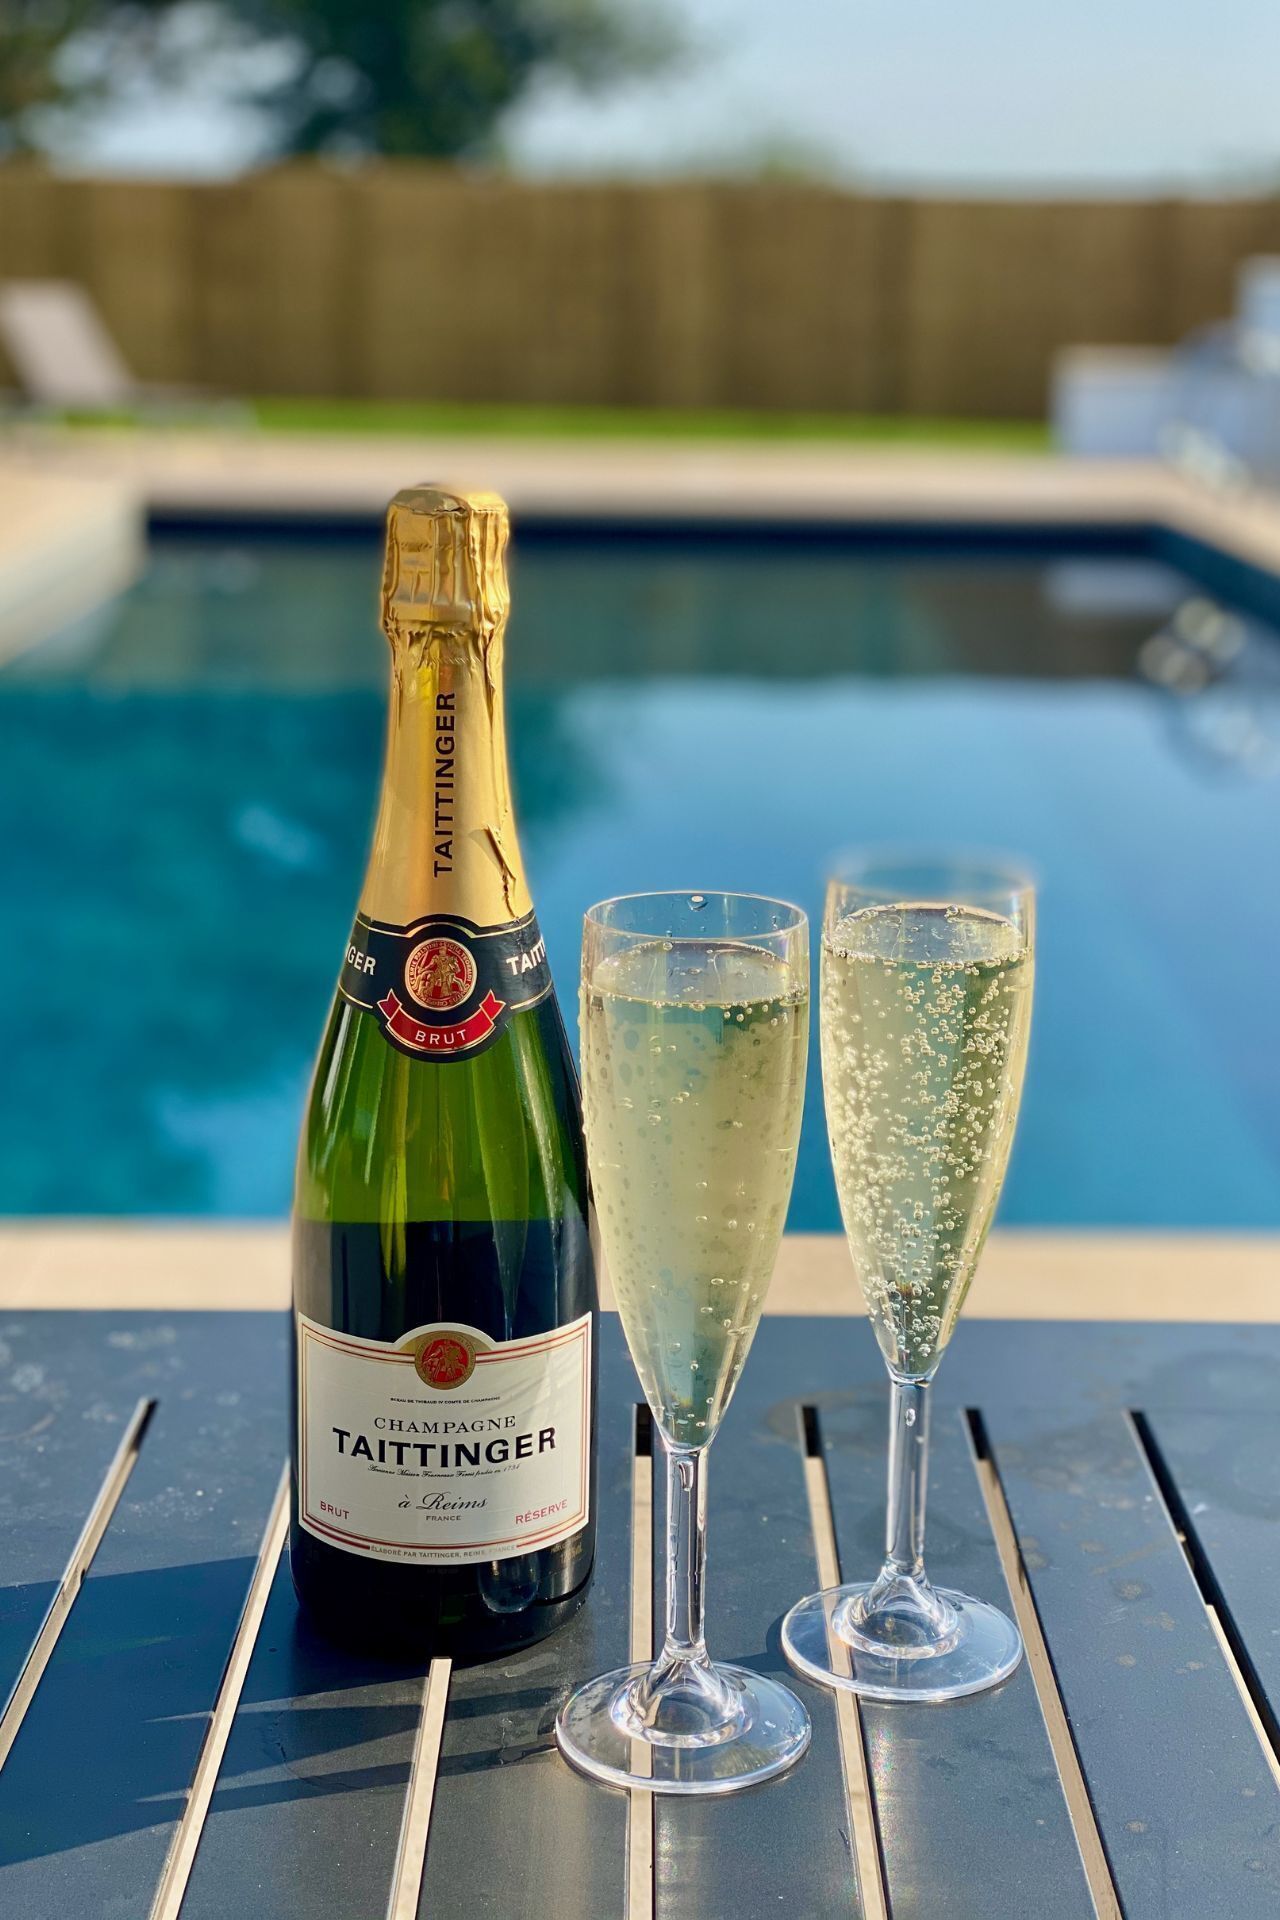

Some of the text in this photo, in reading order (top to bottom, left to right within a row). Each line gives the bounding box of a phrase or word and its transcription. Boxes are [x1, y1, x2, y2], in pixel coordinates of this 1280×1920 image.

[434, 692, 456, 878] TAITTINGER
[414, 1028, 467, 1045] BRUT
[374, 1415, 517, 1434] CHAMPAGNE
[332, 1426, 557, 1468] TAITTINGER
[319, 1500, 350, 1520] BRUT
[397, 1492, 488, 1511] à Reims
[515, 1499, 568, 1525] RÉSERVE
